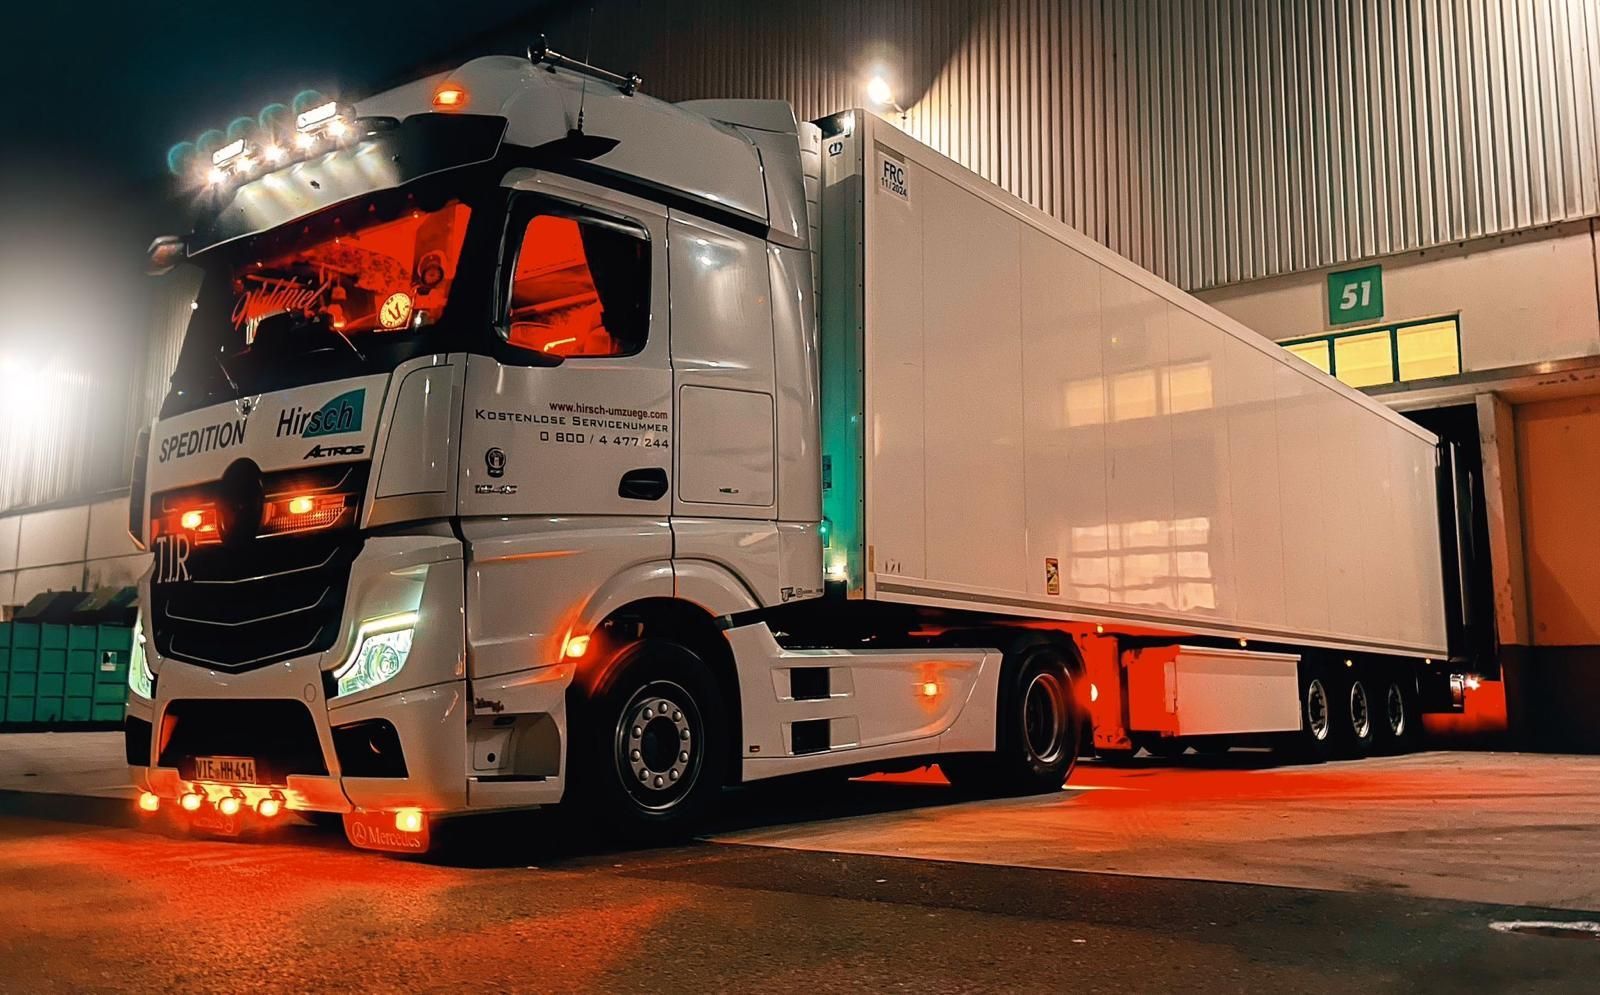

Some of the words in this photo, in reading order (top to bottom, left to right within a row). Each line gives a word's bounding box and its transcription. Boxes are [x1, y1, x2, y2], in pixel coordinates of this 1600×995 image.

[883, 160, 904, 185] FRC
[1339, 280, 1371, 310] 51
[276, 399, 353, 438] Hirsch
[475, 409, 566, 425] KOSTENLOSE
[572, 416, 669, 433] SERVICENUMMER
[549, 402, 668, 420] www.hirsch-umzuege.com
[159, 420, 247, 463] SPEDITION
[556, 432, 585, 443] 800
[599, 436, 608, 445] 4
[613, 436, 639, 447] 477
[644, 438, 669, 448] 244
[196, 760, 213, 779] VIE
[368, 826, 421, 848] Mercedes
